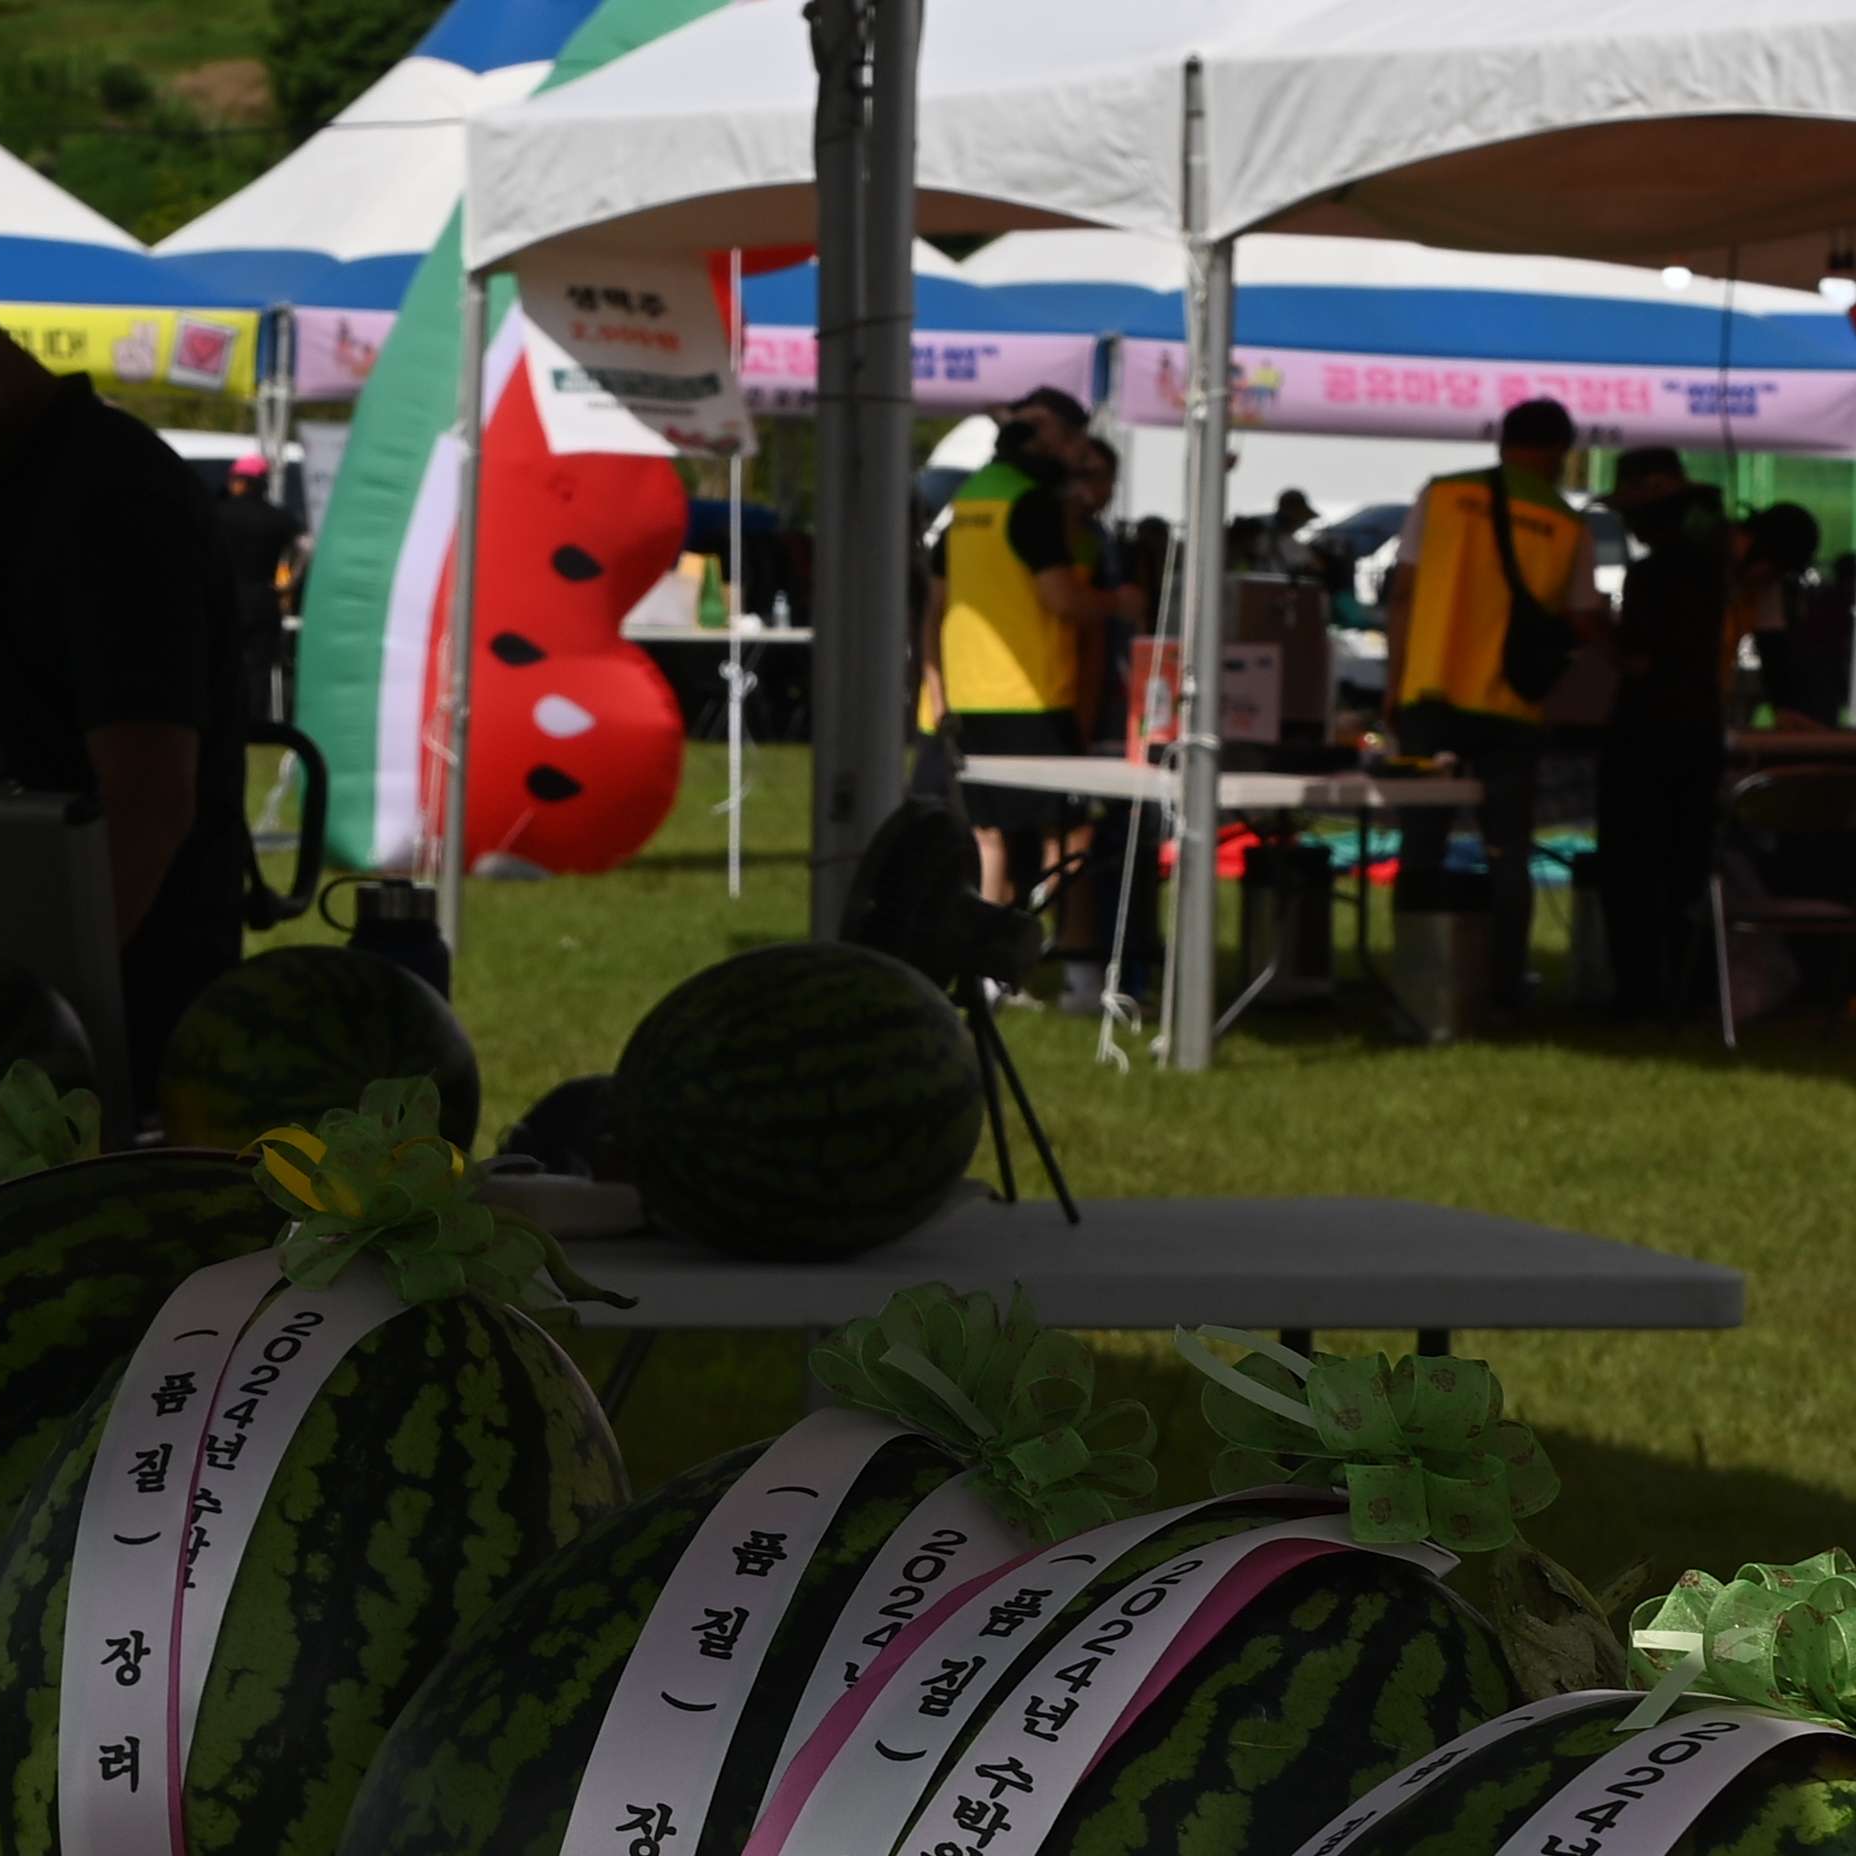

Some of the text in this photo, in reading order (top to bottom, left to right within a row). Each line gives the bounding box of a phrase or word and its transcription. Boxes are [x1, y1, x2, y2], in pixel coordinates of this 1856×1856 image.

[202, 1309, 326, 1472] 2024년
[96, 1327, 220, 1794] (품질) 장려
[659, 1485, 821, 1712] (품질)
[873, 1552, 1098, 1764] (품질)
[1019, 1557, 1206, 1743] 2024년
